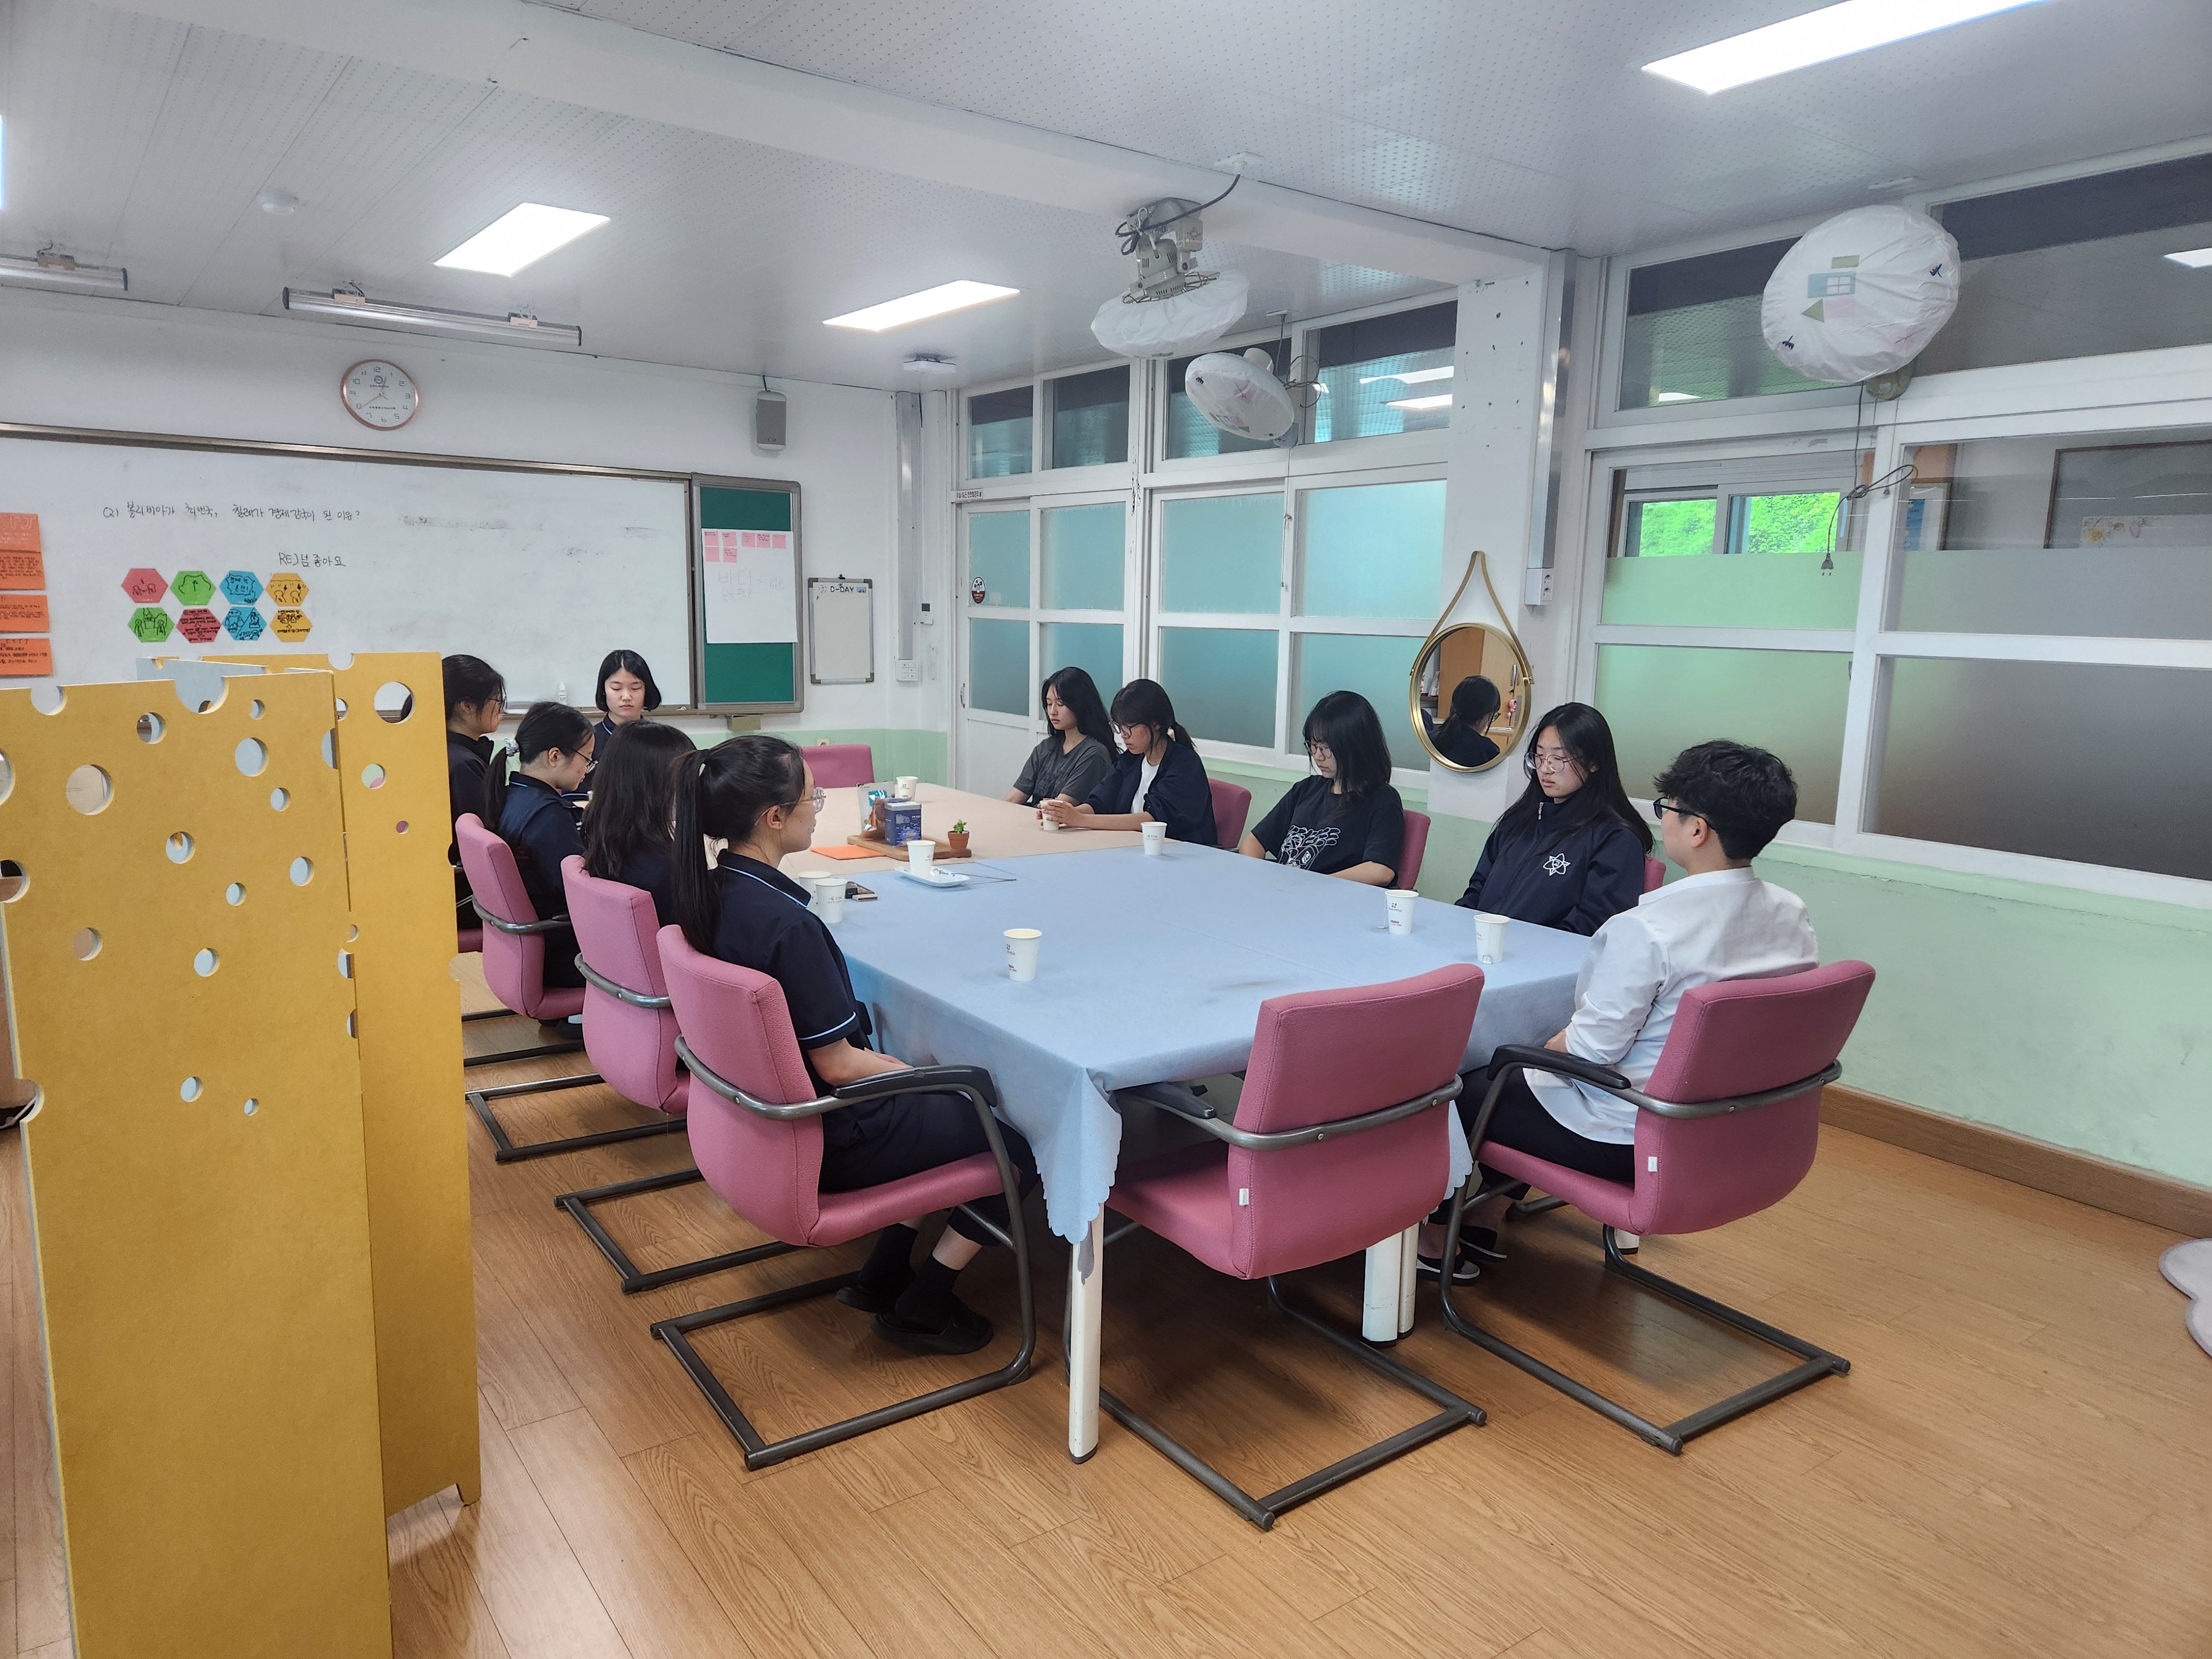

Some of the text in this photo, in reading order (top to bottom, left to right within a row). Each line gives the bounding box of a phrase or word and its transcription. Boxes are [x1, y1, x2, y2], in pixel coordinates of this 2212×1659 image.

[127, 501, 175, 518] 볼리비아가
[232, 504, 263, 518] 칠레가
[268, 507, 315, 521] 경제강국이
[324, 510, 332, 521] 된
[312, 554, 346, 567] 좋아요
